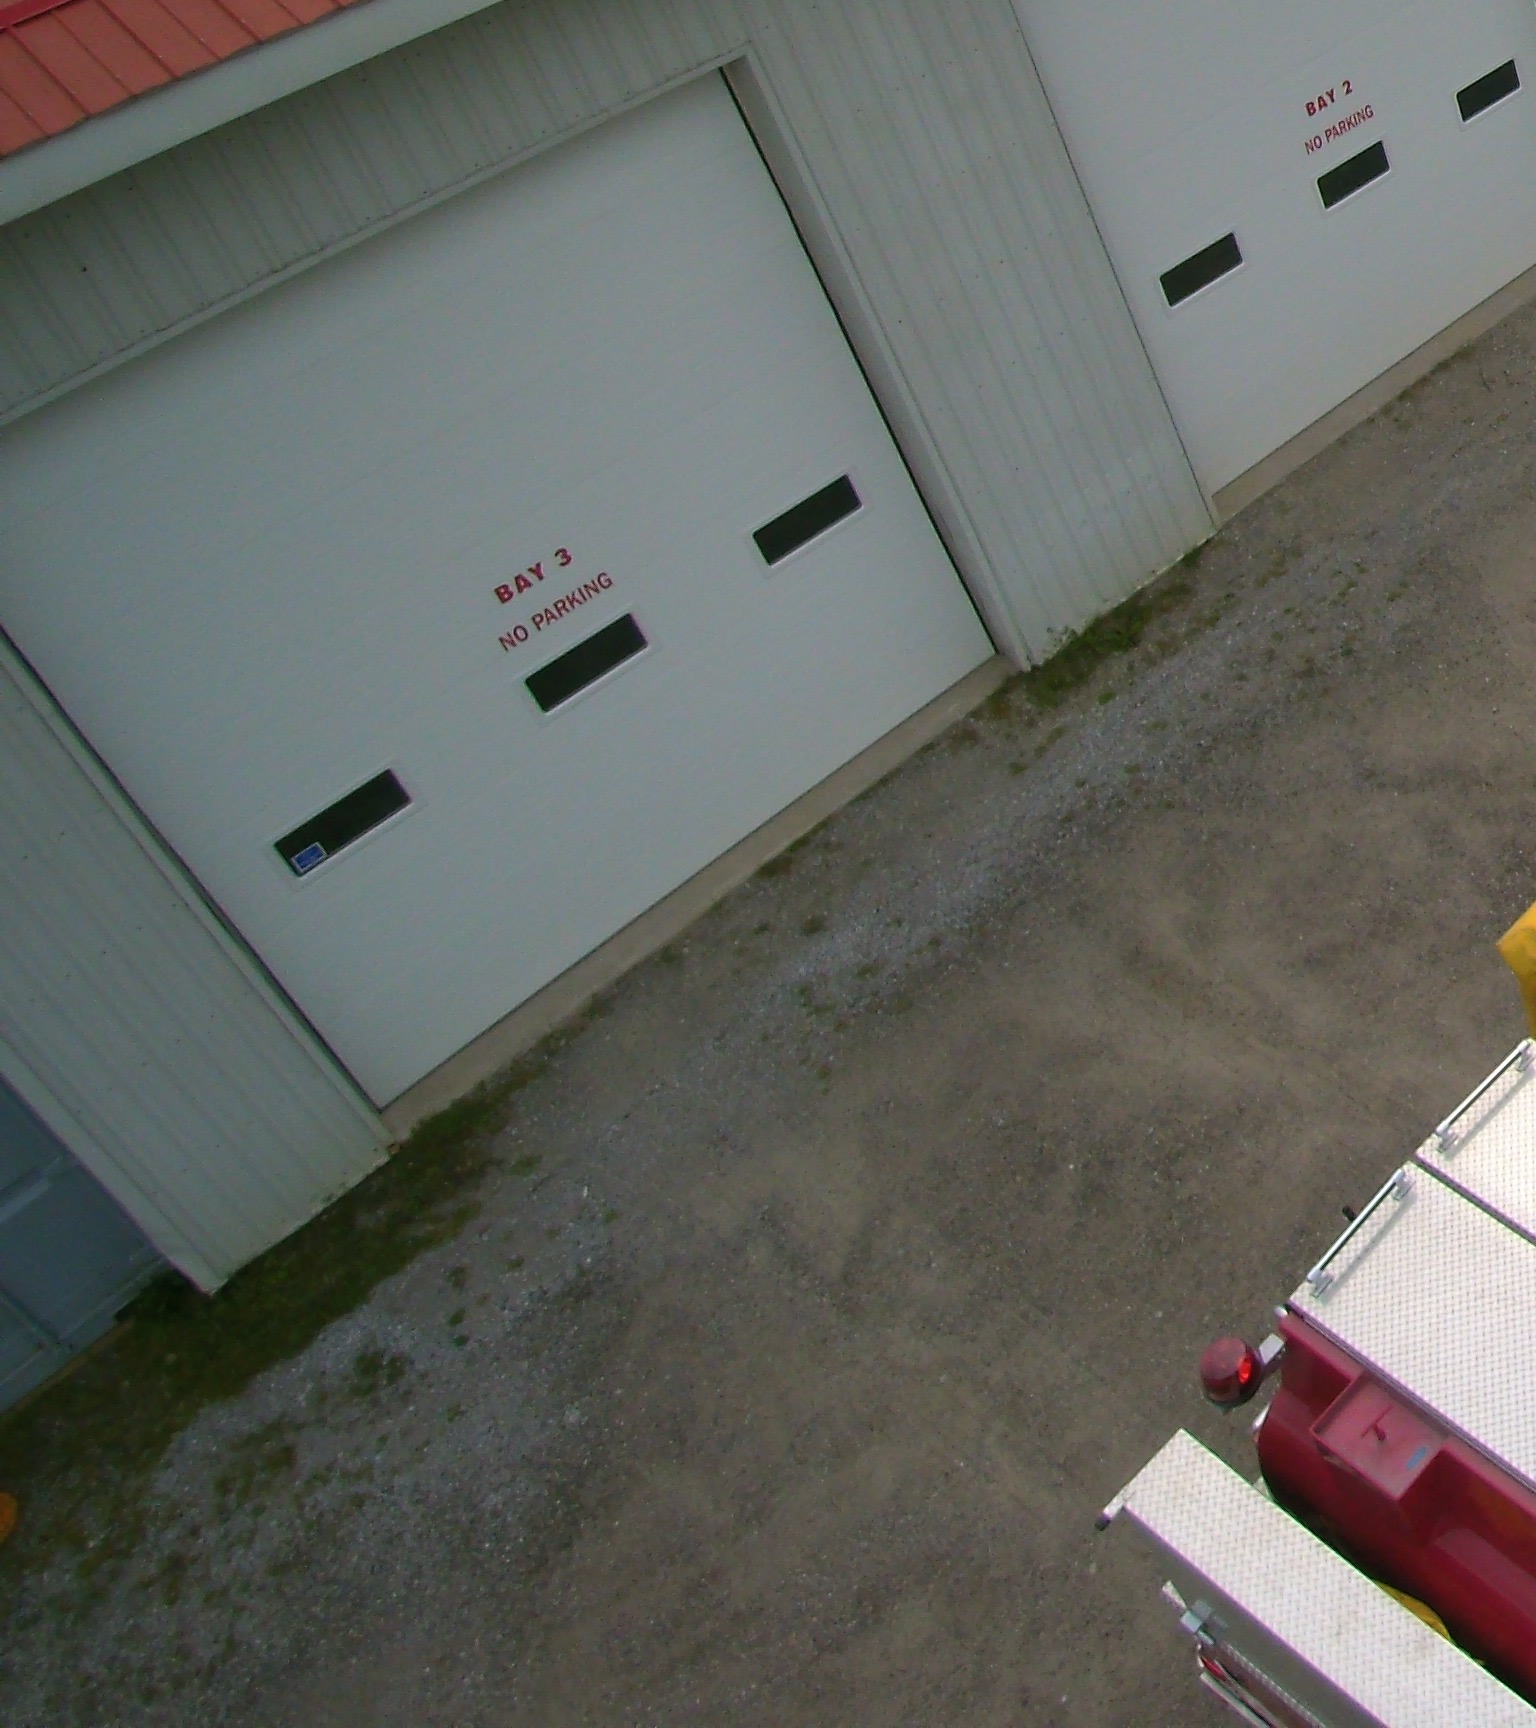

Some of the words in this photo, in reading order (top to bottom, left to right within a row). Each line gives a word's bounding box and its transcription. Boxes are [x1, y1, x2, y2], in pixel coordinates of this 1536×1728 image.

[1305, 88, 1335, 116] BAY
[1342, 80, 1353, 95] 2
[1304, 135, 1322, 155] NO
[1324, 104, 1375, 143] PARKING
[494, 562, 545, 604] BAY
[554, 547, 573, 567] 3
[498, 624, 529, 652] NO
[531, 572, 613, 631] PARKING
